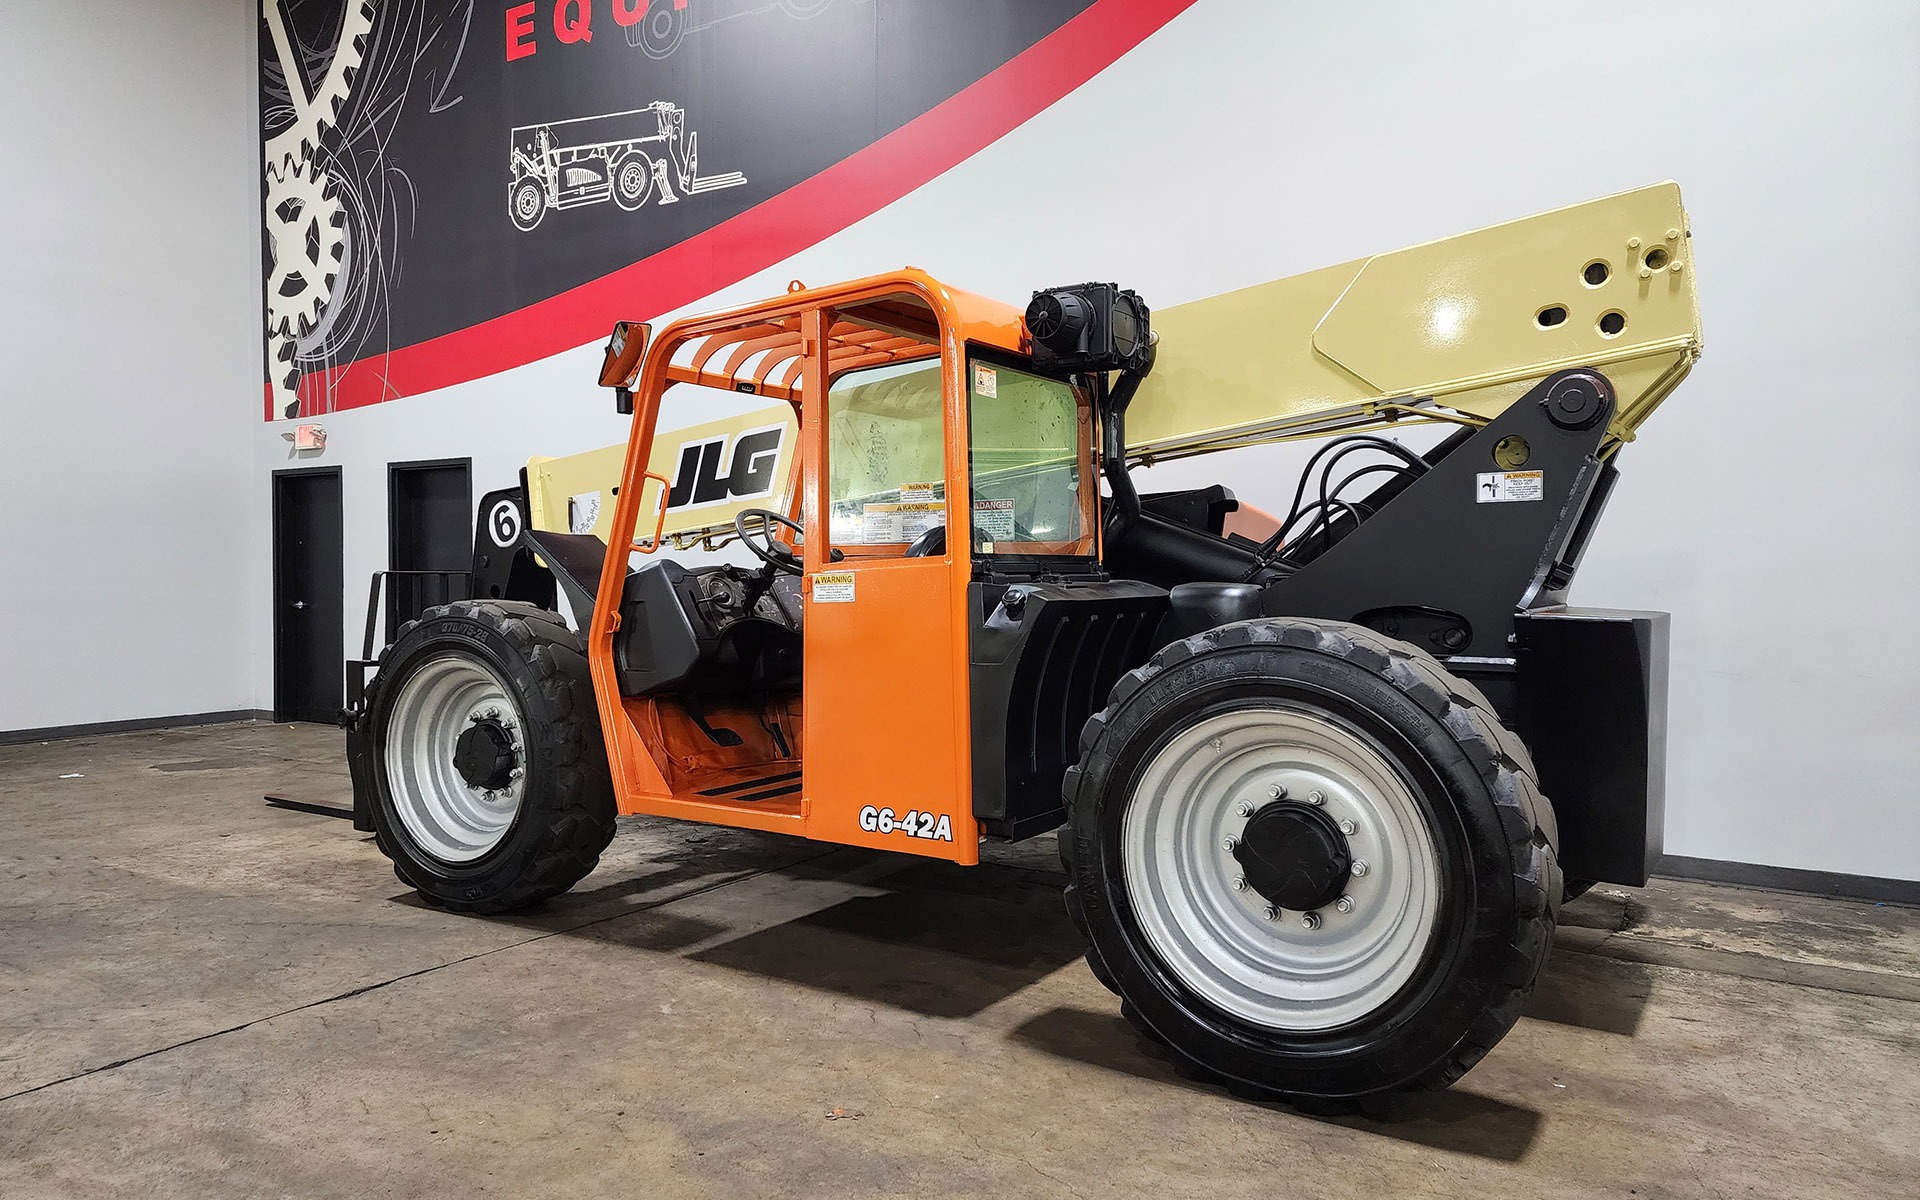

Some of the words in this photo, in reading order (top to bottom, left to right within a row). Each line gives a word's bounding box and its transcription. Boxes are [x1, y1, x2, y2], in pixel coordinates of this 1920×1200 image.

[505, 0, 688, 62] EQU
[658, 427, 783, 510] JLG
[493, 502, 518, 544] 6
[979, 501, 1013, 509] DANGER
[820, 575, 853, 584] WARNING
[859, 804, 954, 842] G6-42A
